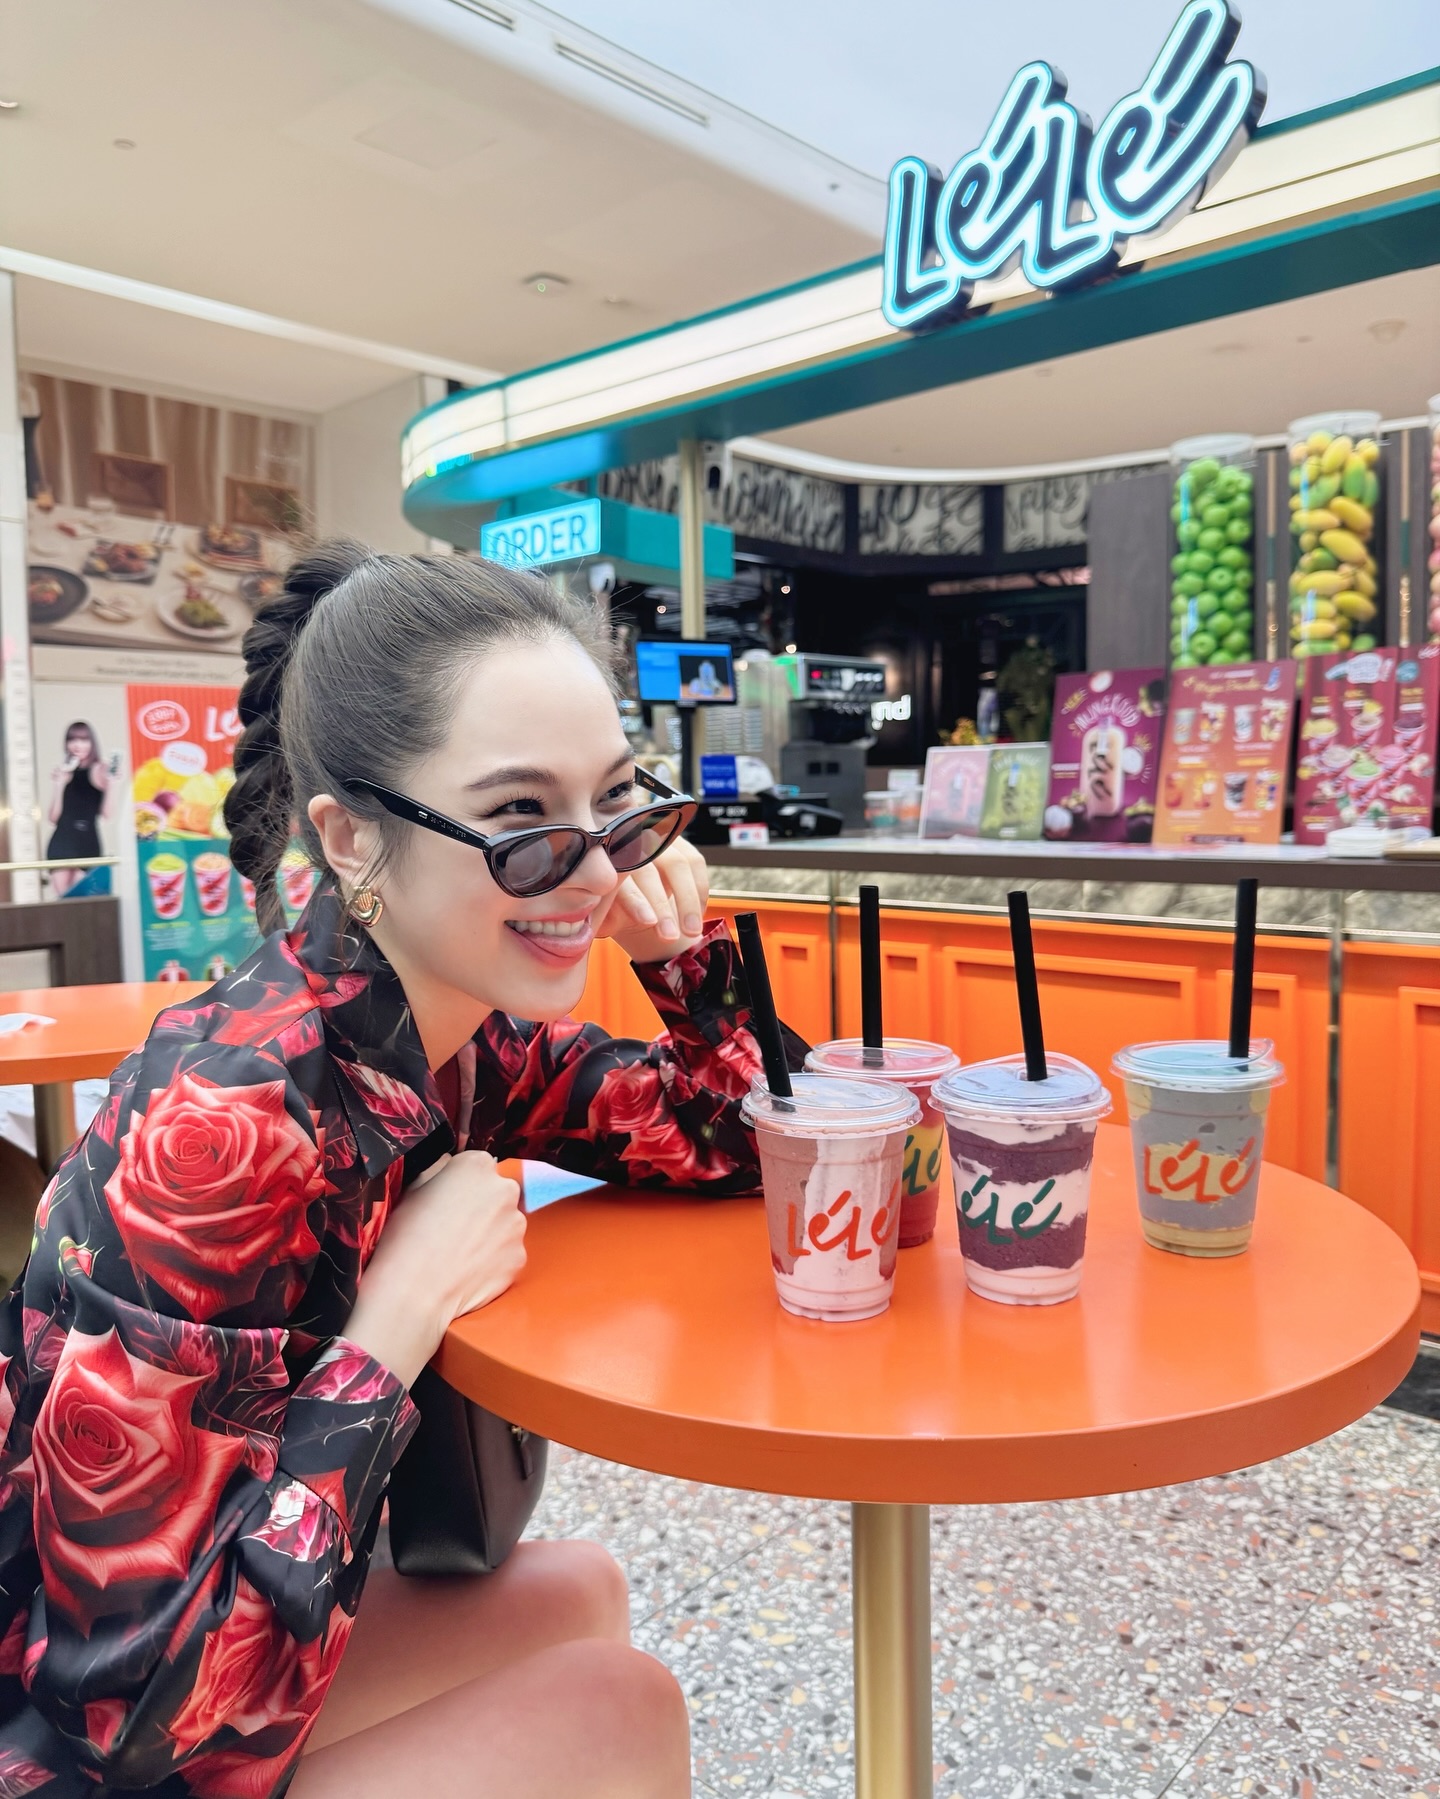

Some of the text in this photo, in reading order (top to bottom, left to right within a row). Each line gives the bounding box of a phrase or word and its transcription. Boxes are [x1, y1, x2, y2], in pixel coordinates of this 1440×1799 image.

[882, 0, 1256, 328] LéLé
[494, 514, 587, 563] ORDER
[1143, 1135, 1257, 1204] LéLé
[787, 1179, 901, 1261] LéLé
[961, 1174, 1063, 1246] éLé
